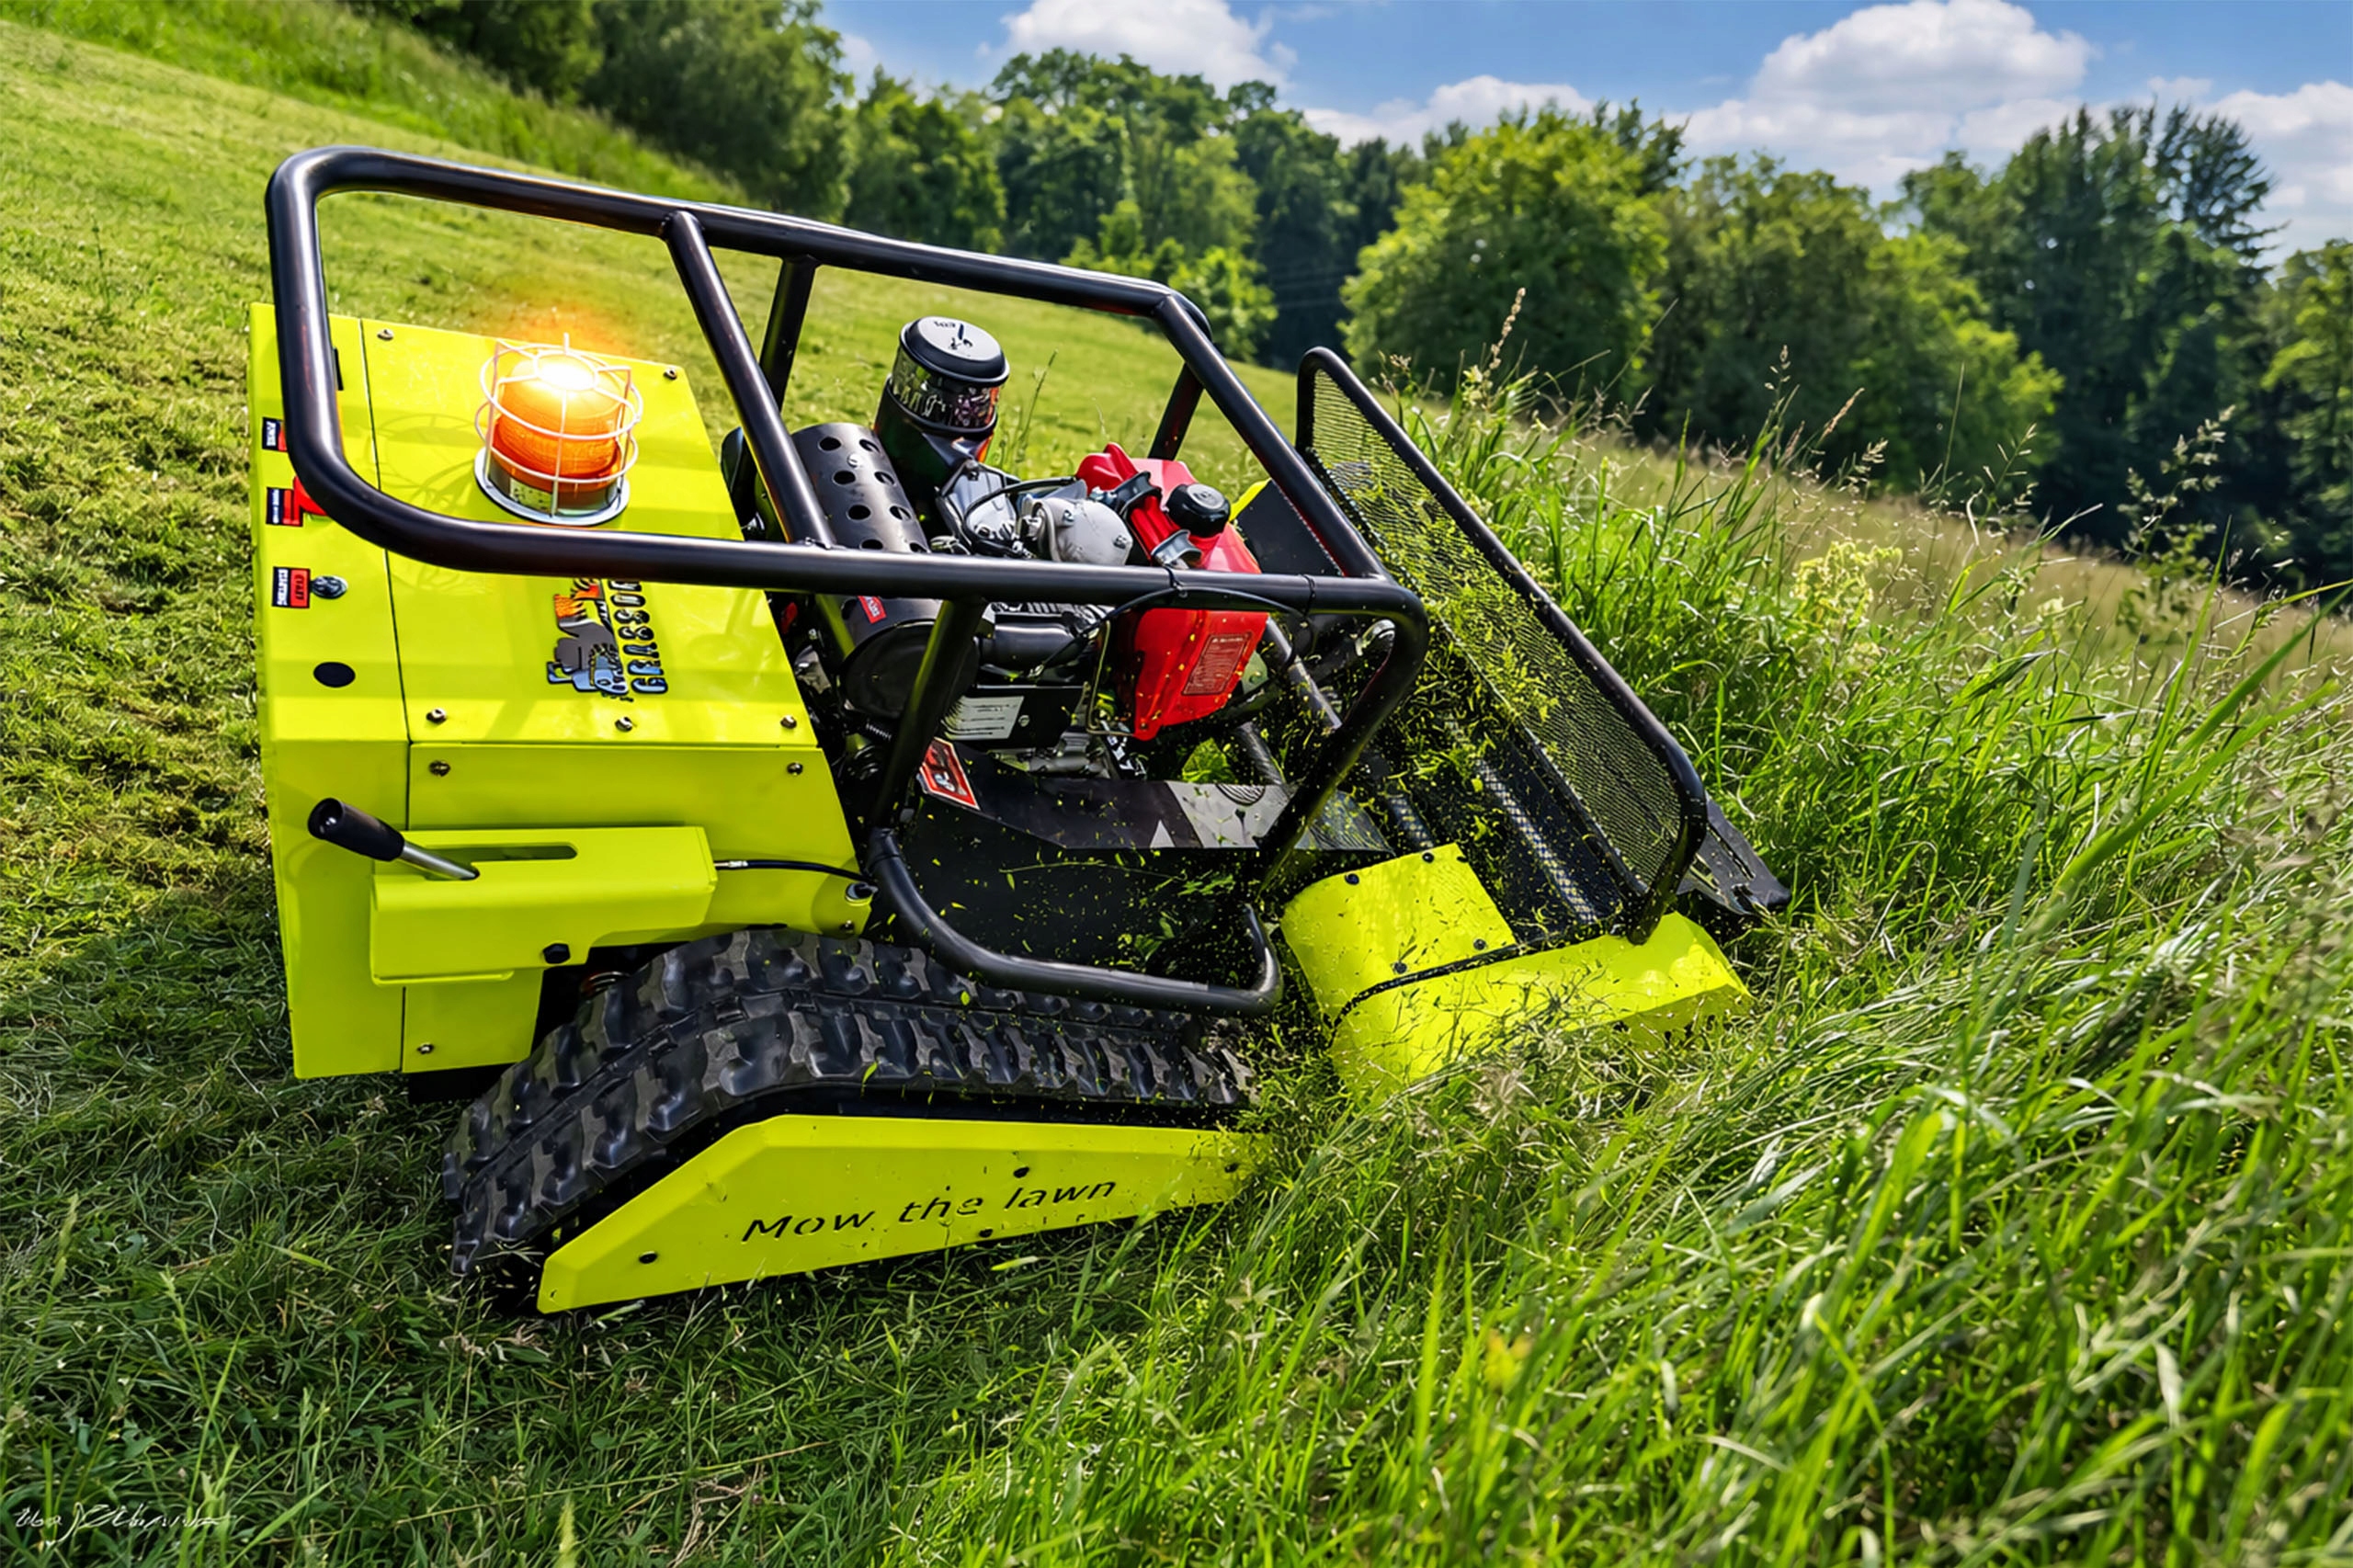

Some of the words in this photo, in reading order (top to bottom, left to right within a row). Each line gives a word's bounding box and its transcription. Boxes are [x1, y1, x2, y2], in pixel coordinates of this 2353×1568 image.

[741, 1210, 875, 1243] Mow
[897, 1196, 983, 1223] the
[1003, 1180, 1117, 1211] lawn
